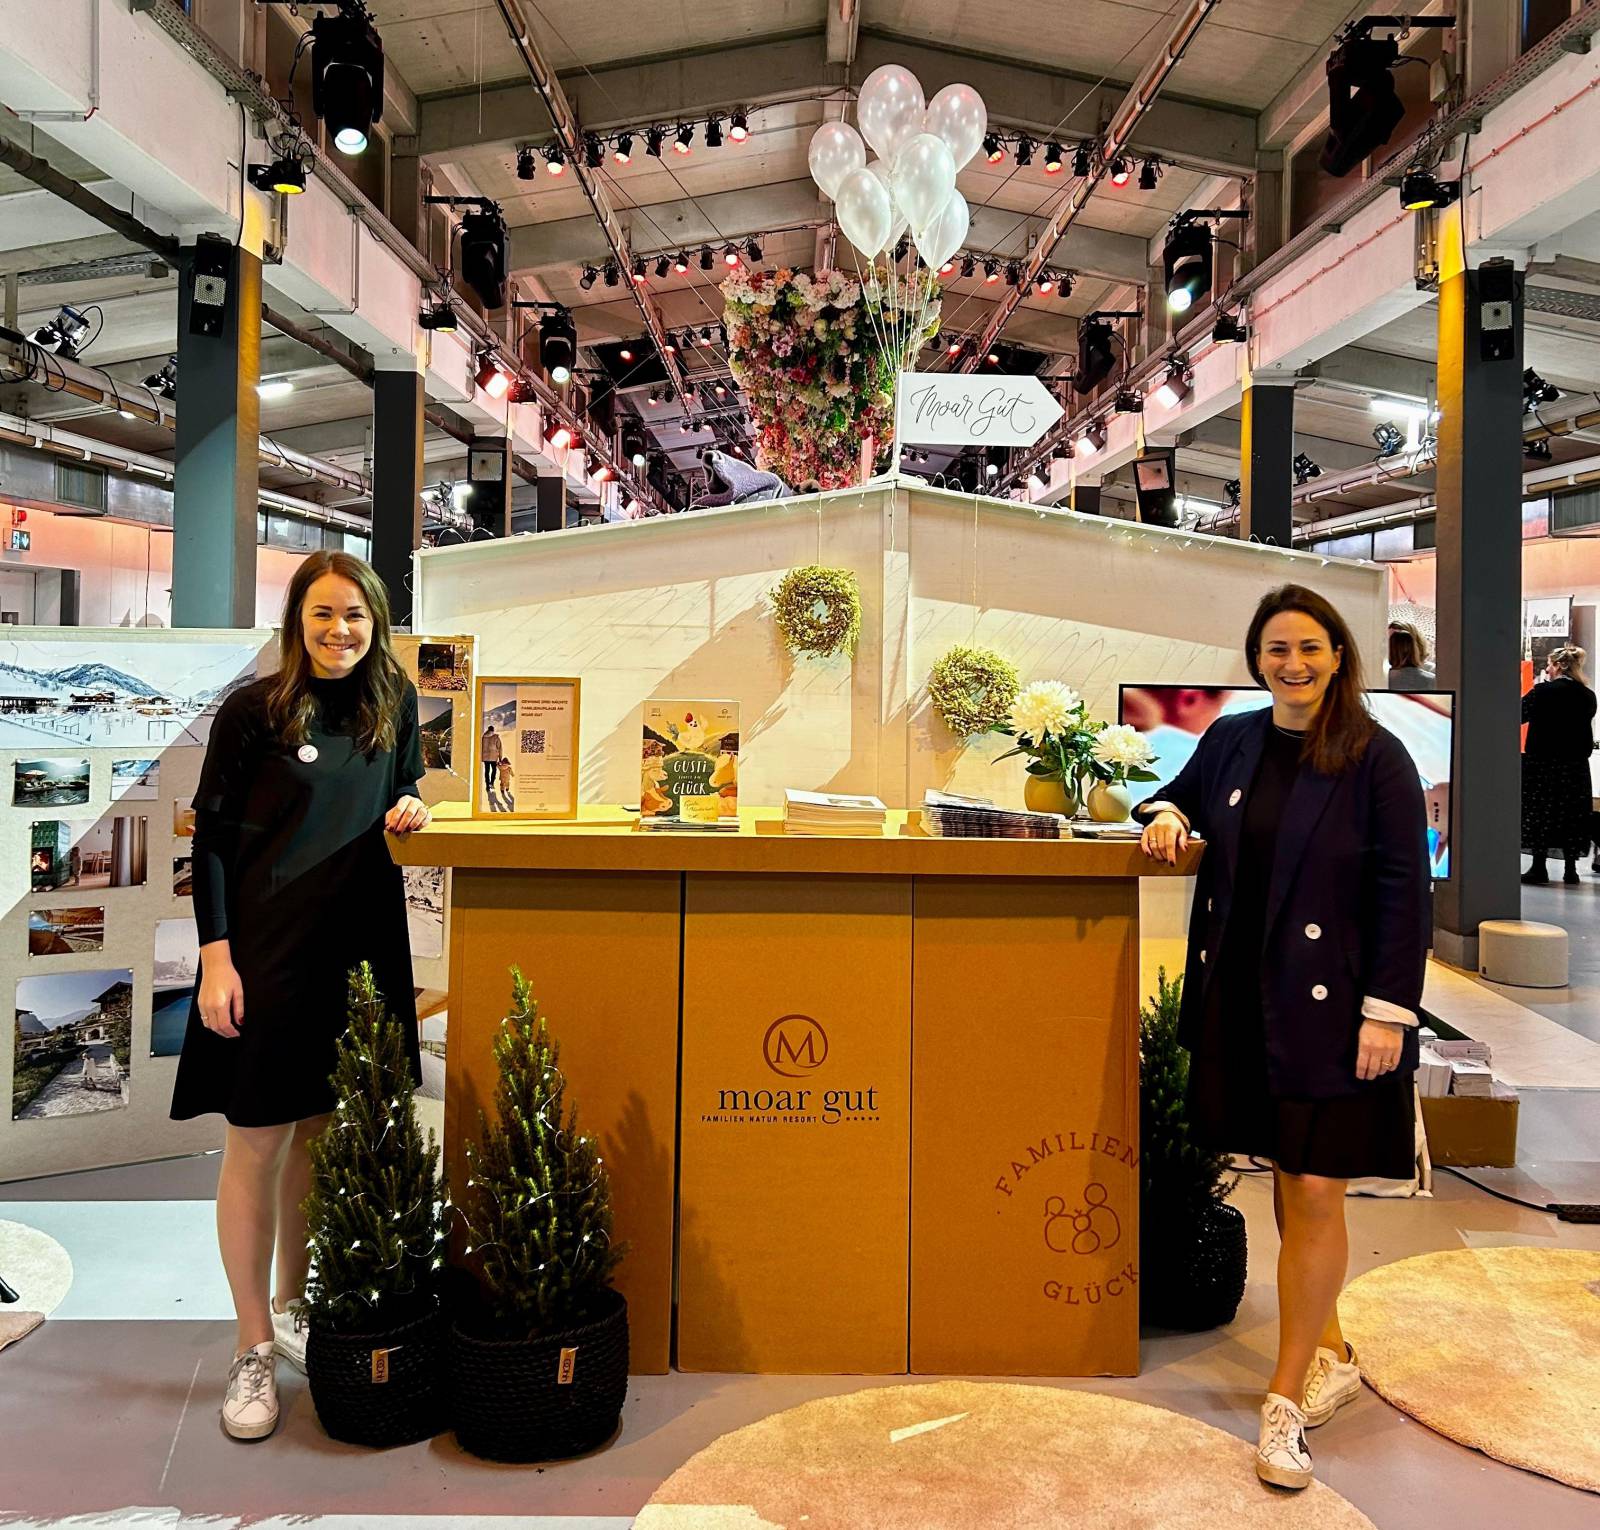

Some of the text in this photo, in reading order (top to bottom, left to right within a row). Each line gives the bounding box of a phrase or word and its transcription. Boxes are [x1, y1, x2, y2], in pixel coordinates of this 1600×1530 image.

[911, 384, 1036, 436] Moar Gut
[672, 781, 706, 795] GLÜCK
[701, 1114, 817, 1124] FAMILIEN NATUR RESORT
[718, 1086, 879, 1125] moar gut
[995, 1132, 1139, 1197] FAMILIEN
[1043, 1263, 1139, 1306] GLÜCK
